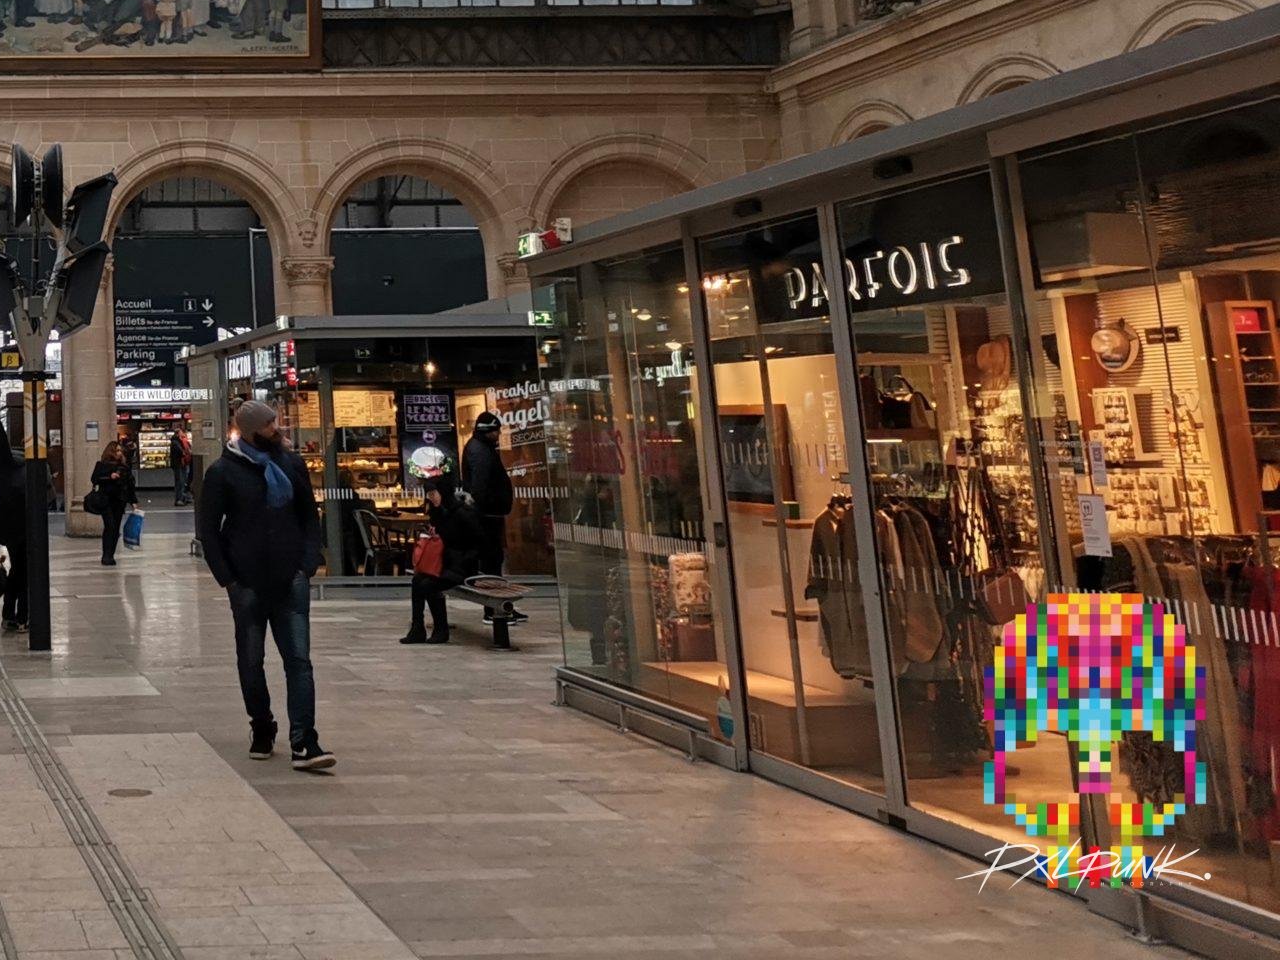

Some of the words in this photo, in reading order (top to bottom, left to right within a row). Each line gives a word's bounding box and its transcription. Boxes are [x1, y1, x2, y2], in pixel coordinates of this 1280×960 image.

[784, 235, 971, 310] PARFOIS
[116, 299, 152, 308] Accueil
[115, 316, 147, 326] Billets
[117, 334, 147, 343] Agence
[116, 349, 155, 361] Parking
[116, 388, 145, 399] SUPER
[147, 388, 171, 400] WILD
